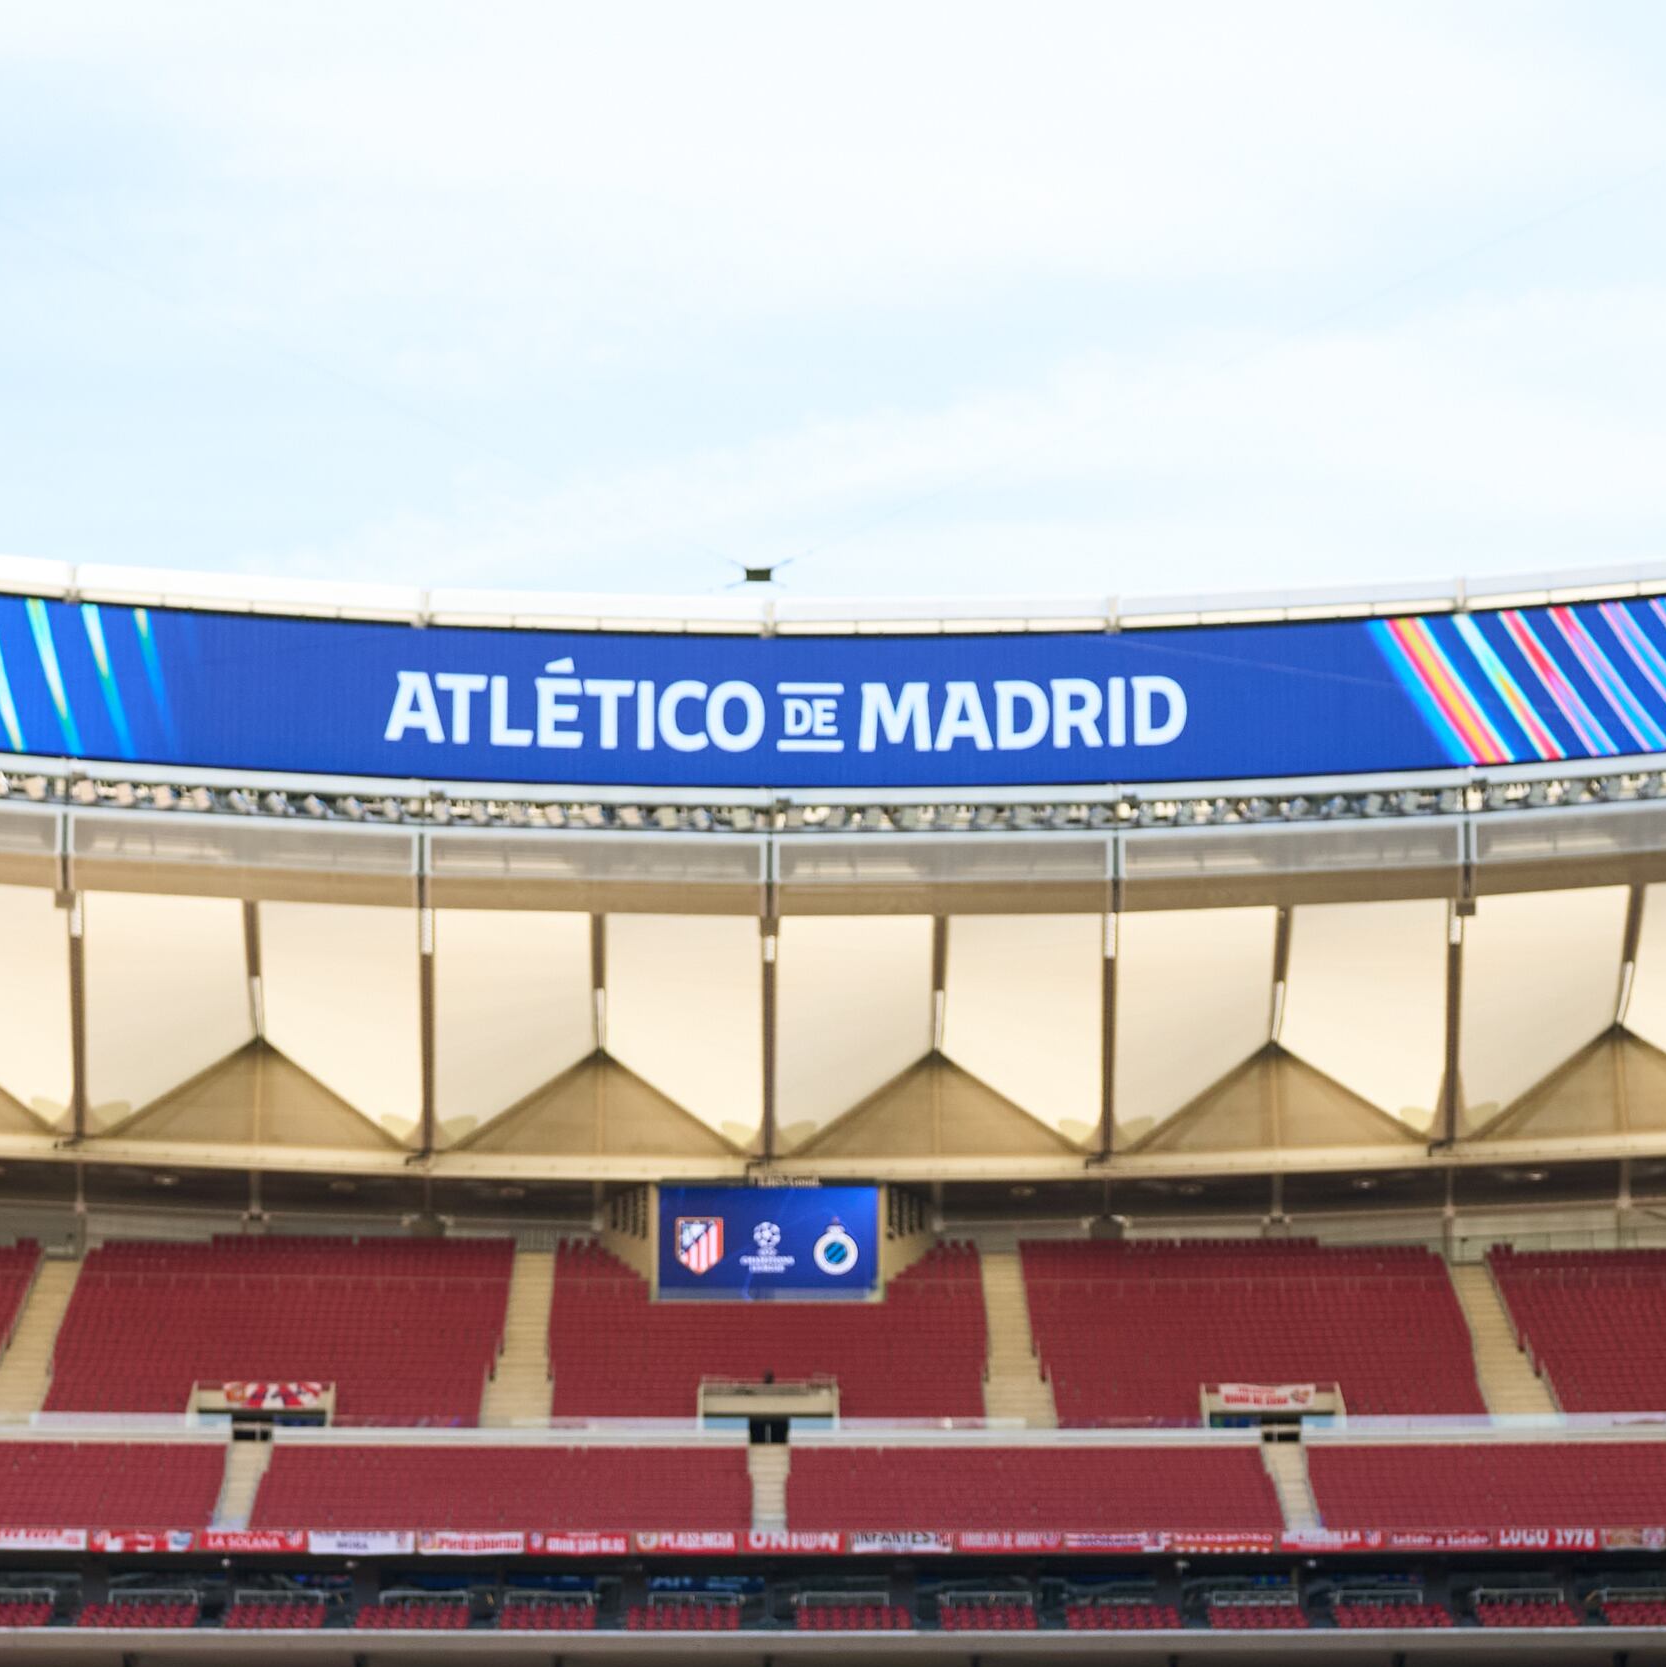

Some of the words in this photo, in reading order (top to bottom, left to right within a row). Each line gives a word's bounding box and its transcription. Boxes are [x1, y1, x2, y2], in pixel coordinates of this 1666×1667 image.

[383, 657, 765, 752] ATLÉTICO
[783, 696, 839, 738] DE
[858, 675, 1188, 754] MADRID
